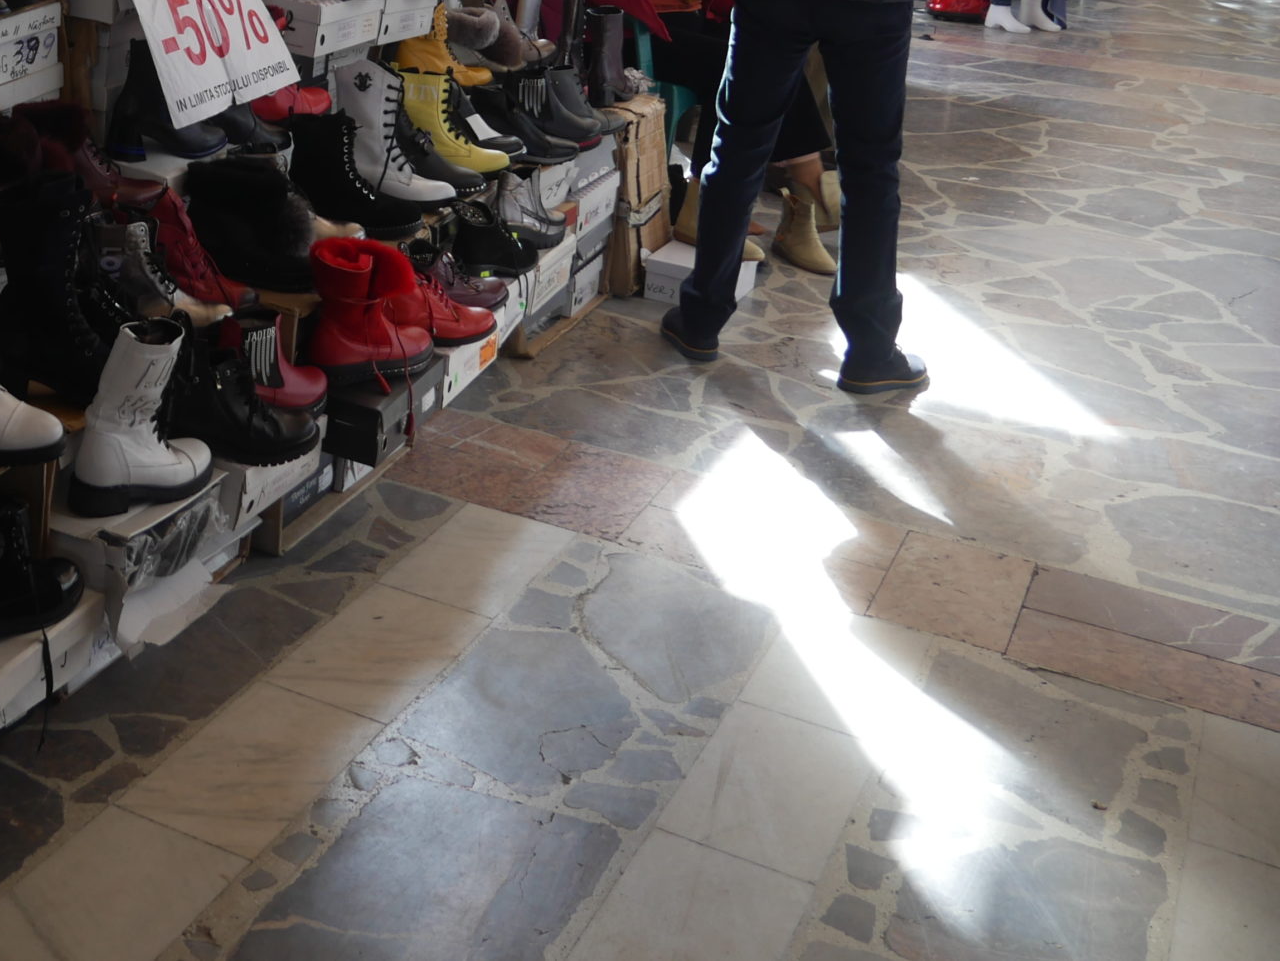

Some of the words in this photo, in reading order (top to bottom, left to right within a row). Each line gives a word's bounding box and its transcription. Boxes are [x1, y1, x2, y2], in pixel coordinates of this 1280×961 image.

[176, 99, 188, 112] IN
[189, 88, 215, 108] LIMITA
[251, 60, 290, 85] DISPONIBIL
